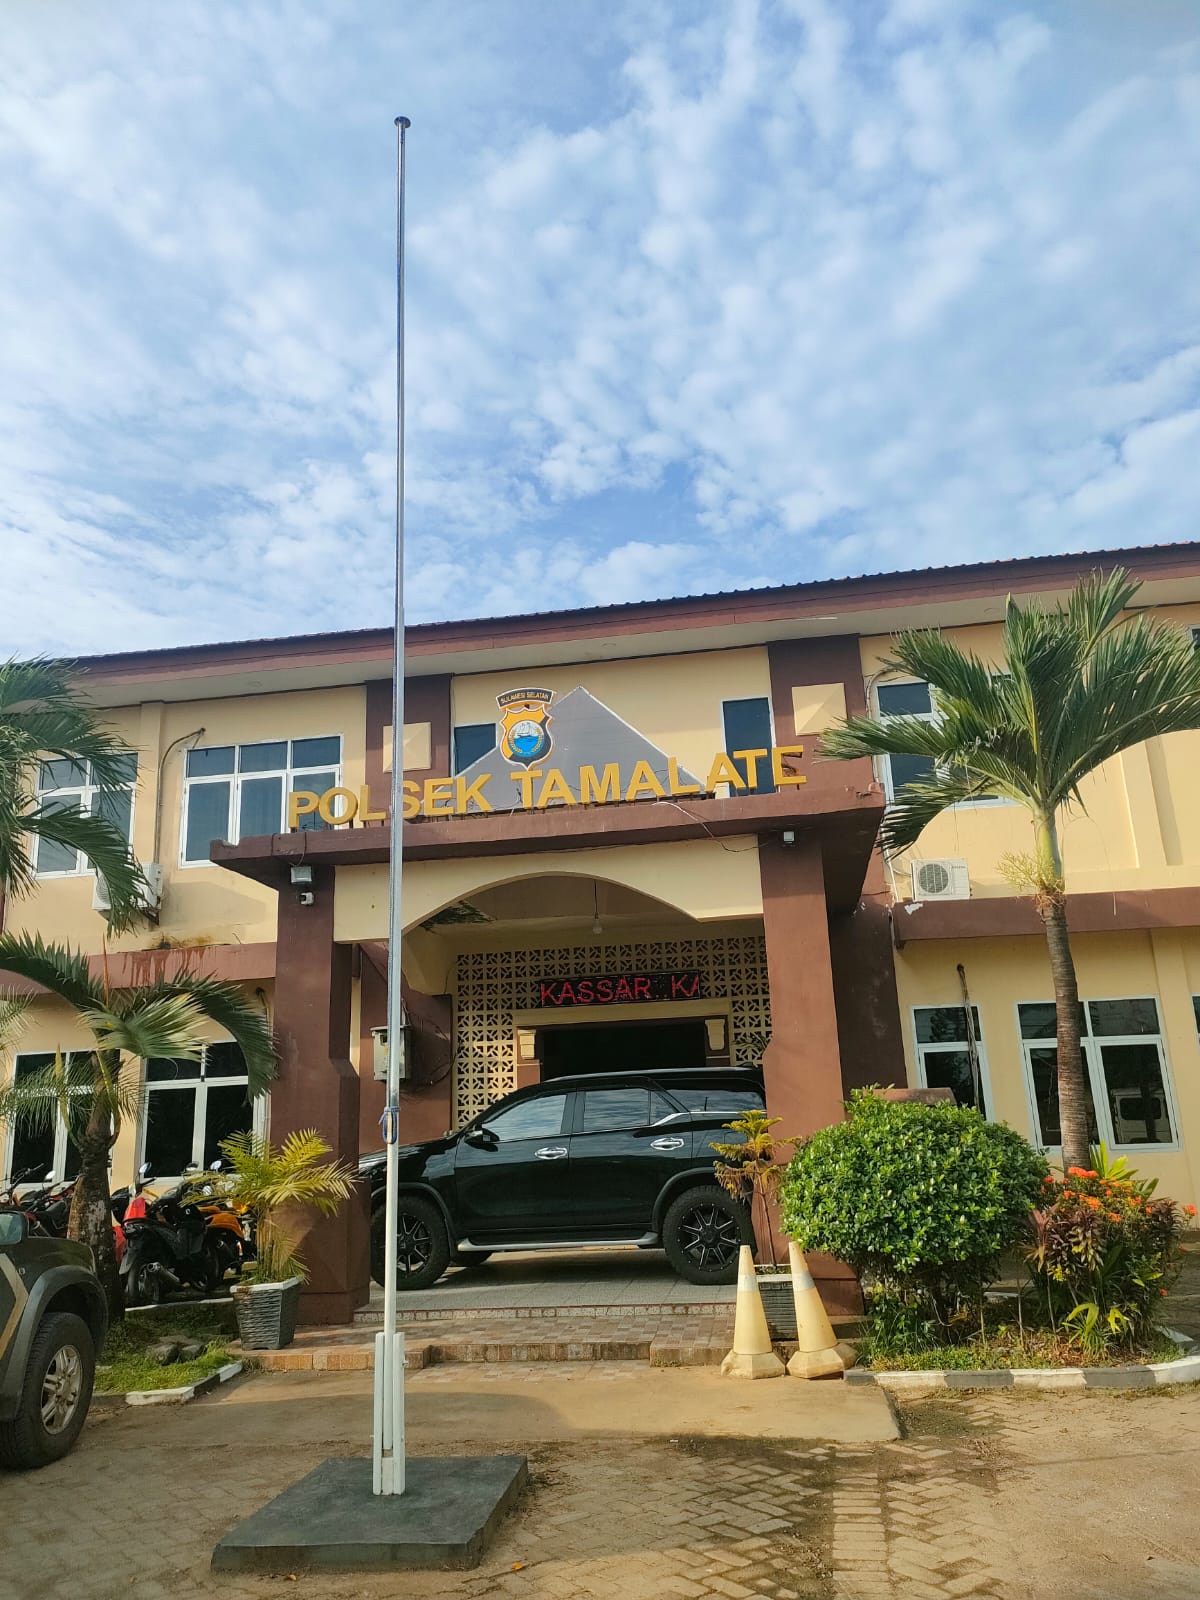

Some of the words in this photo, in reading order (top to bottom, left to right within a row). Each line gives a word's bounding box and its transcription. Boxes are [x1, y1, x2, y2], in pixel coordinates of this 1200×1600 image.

[501, 692, 525, 704] SULAWESI
[527, 691, 549, 700] SELATAN
[288, 773, 493, 827] POLSEK
[510, 745, 807, 809] TAMALATE
